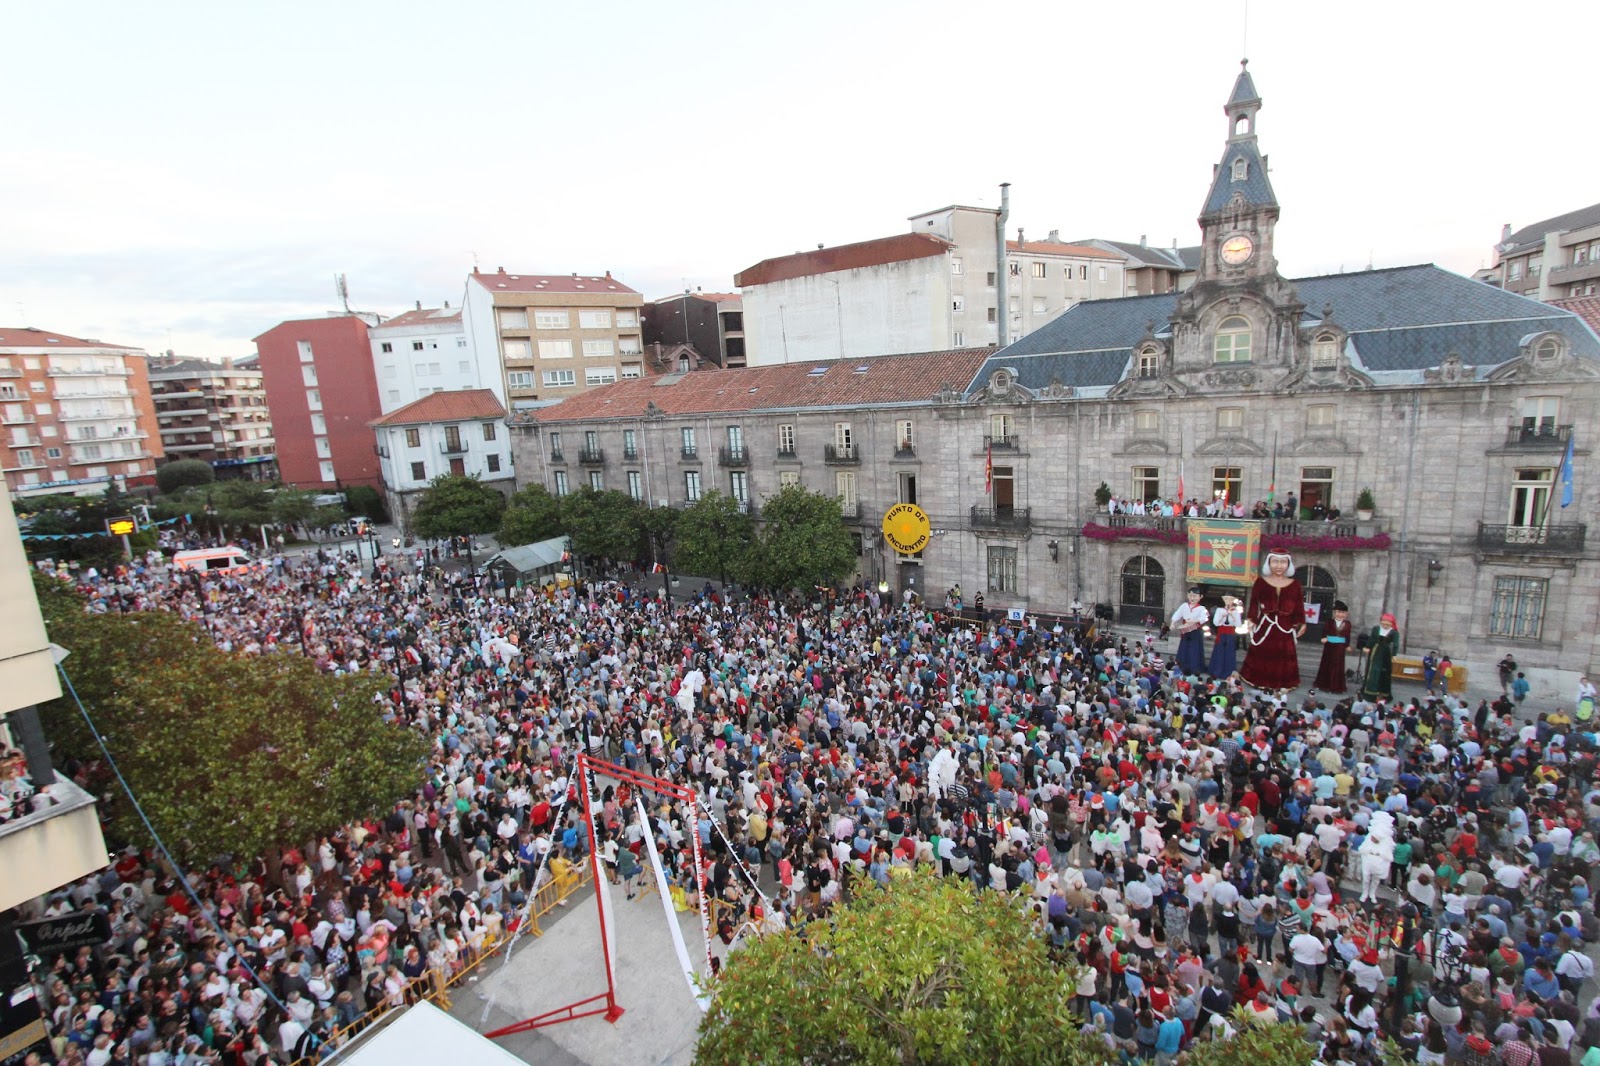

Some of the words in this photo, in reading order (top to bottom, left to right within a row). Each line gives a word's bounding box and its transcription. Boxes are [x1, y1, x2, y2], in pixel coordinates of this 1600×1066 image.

[887, 505, 913, 521] PUNTO
[914, 511, 926, 523] DE
[887, 533, 926, 551] ENCUENTRO
